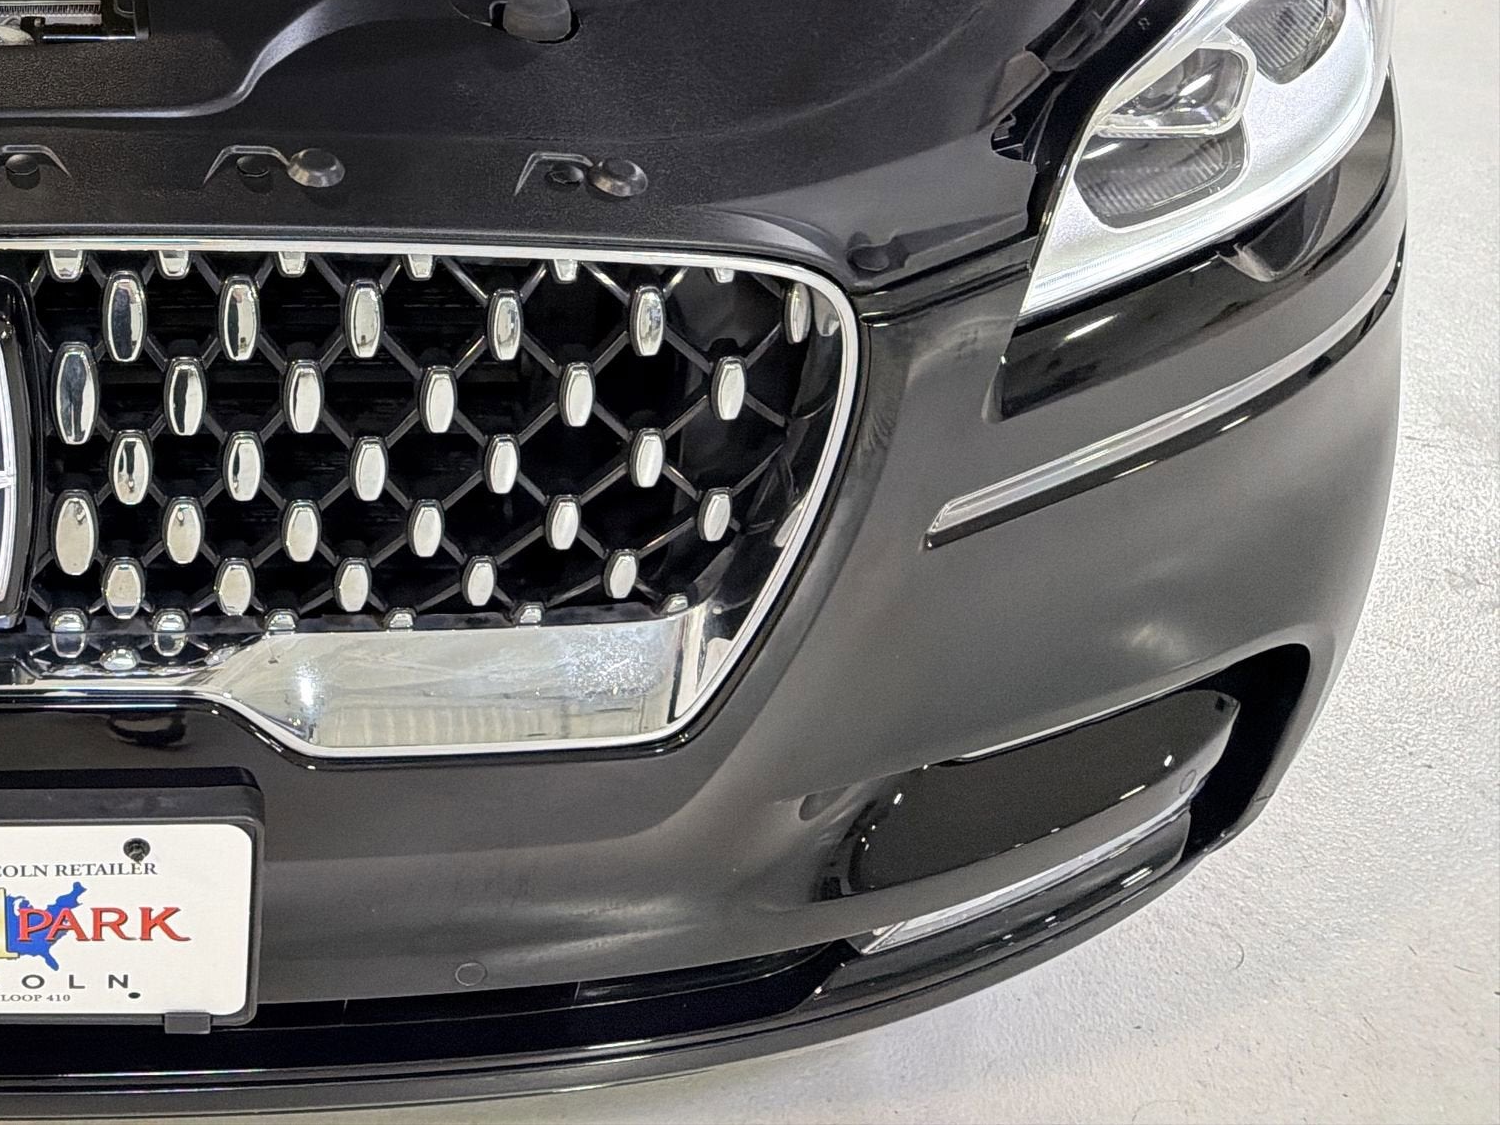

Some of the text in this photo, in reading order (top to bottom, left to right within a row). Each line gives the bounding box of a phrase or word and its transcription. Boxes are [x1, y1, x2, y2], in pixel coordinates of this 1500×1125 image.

[55, 862, 159, 877] RETAILER
[17, 906, 192, 942] PARK
[0, 993, 43, 1002] LOOP
[46, 993, 71, 1002] 410
